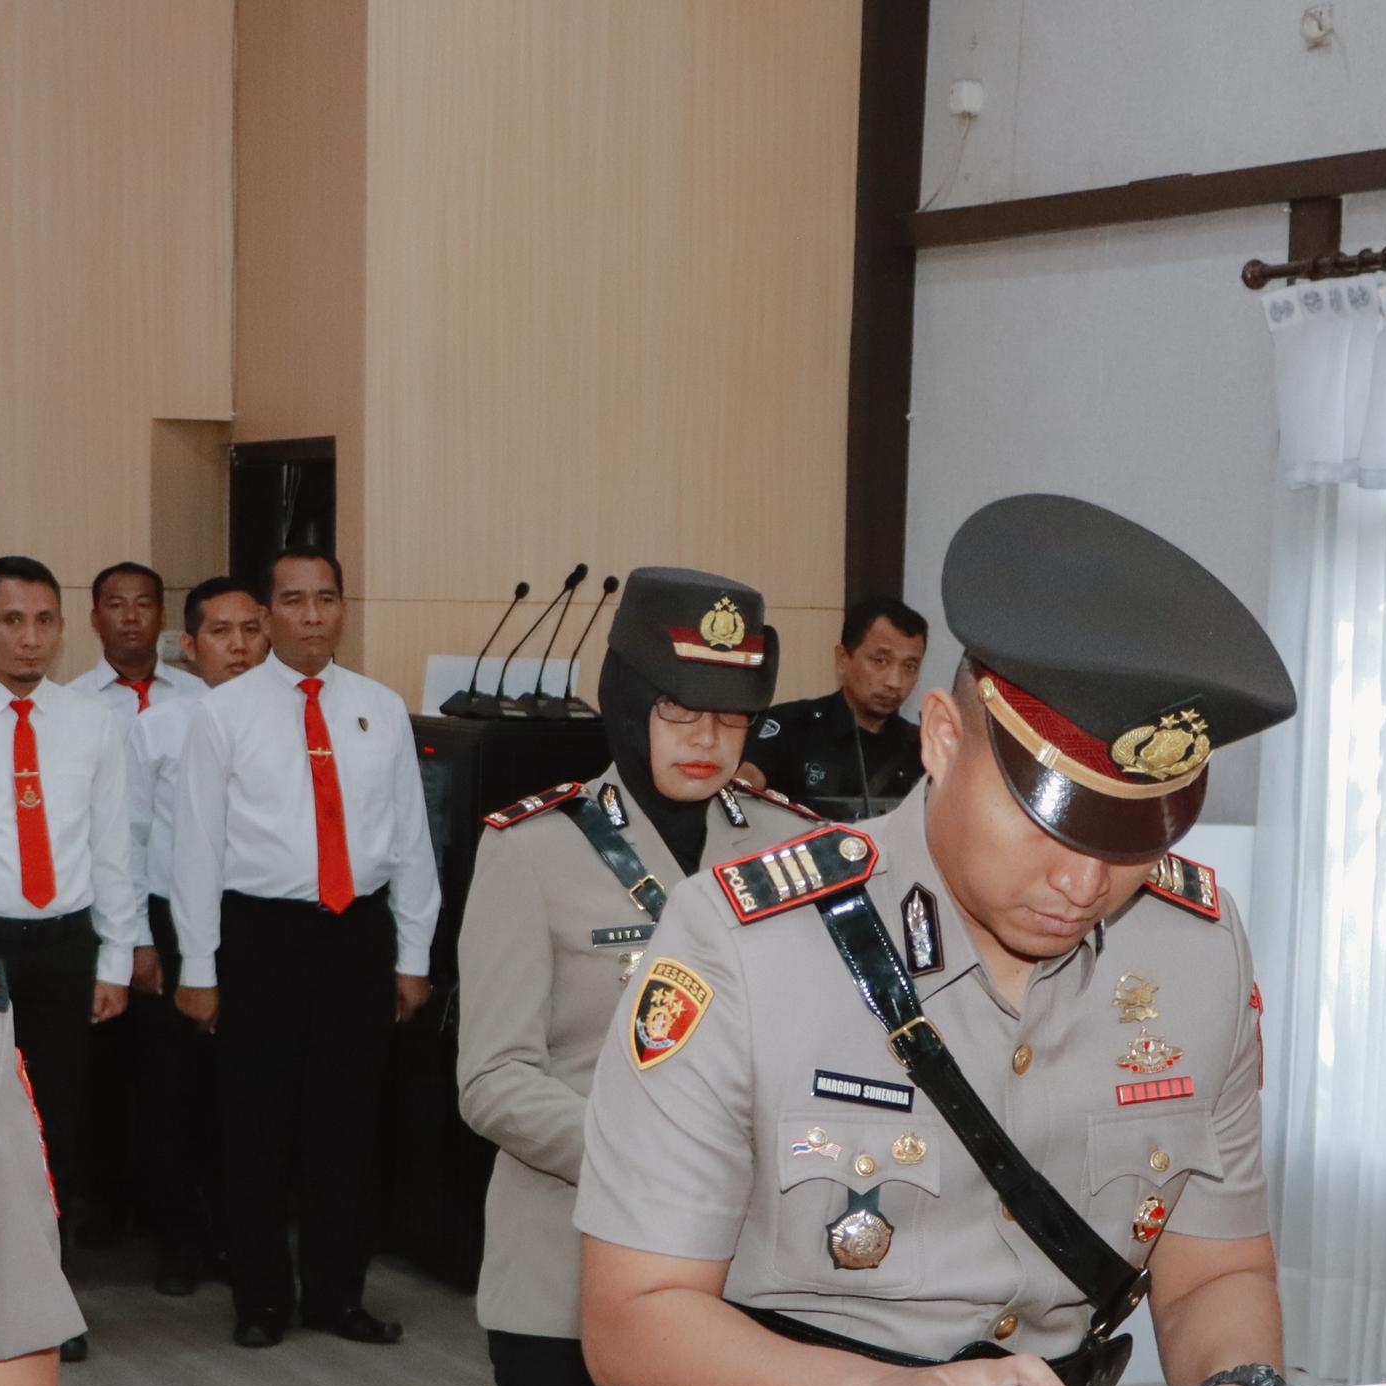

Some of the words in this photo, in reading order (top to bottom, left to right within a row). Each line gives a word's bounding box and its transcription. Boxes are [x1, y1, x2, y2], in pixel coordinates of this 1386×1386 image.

[723, 866, 758, 912] POLISI
[608, 929, 642, 941] RITA
[655, 963, 707, 1002] RESERSE
[816, 1076, 862, 1097] MARGONO
[863, 1084, 910, 1106] SUHENDRA
